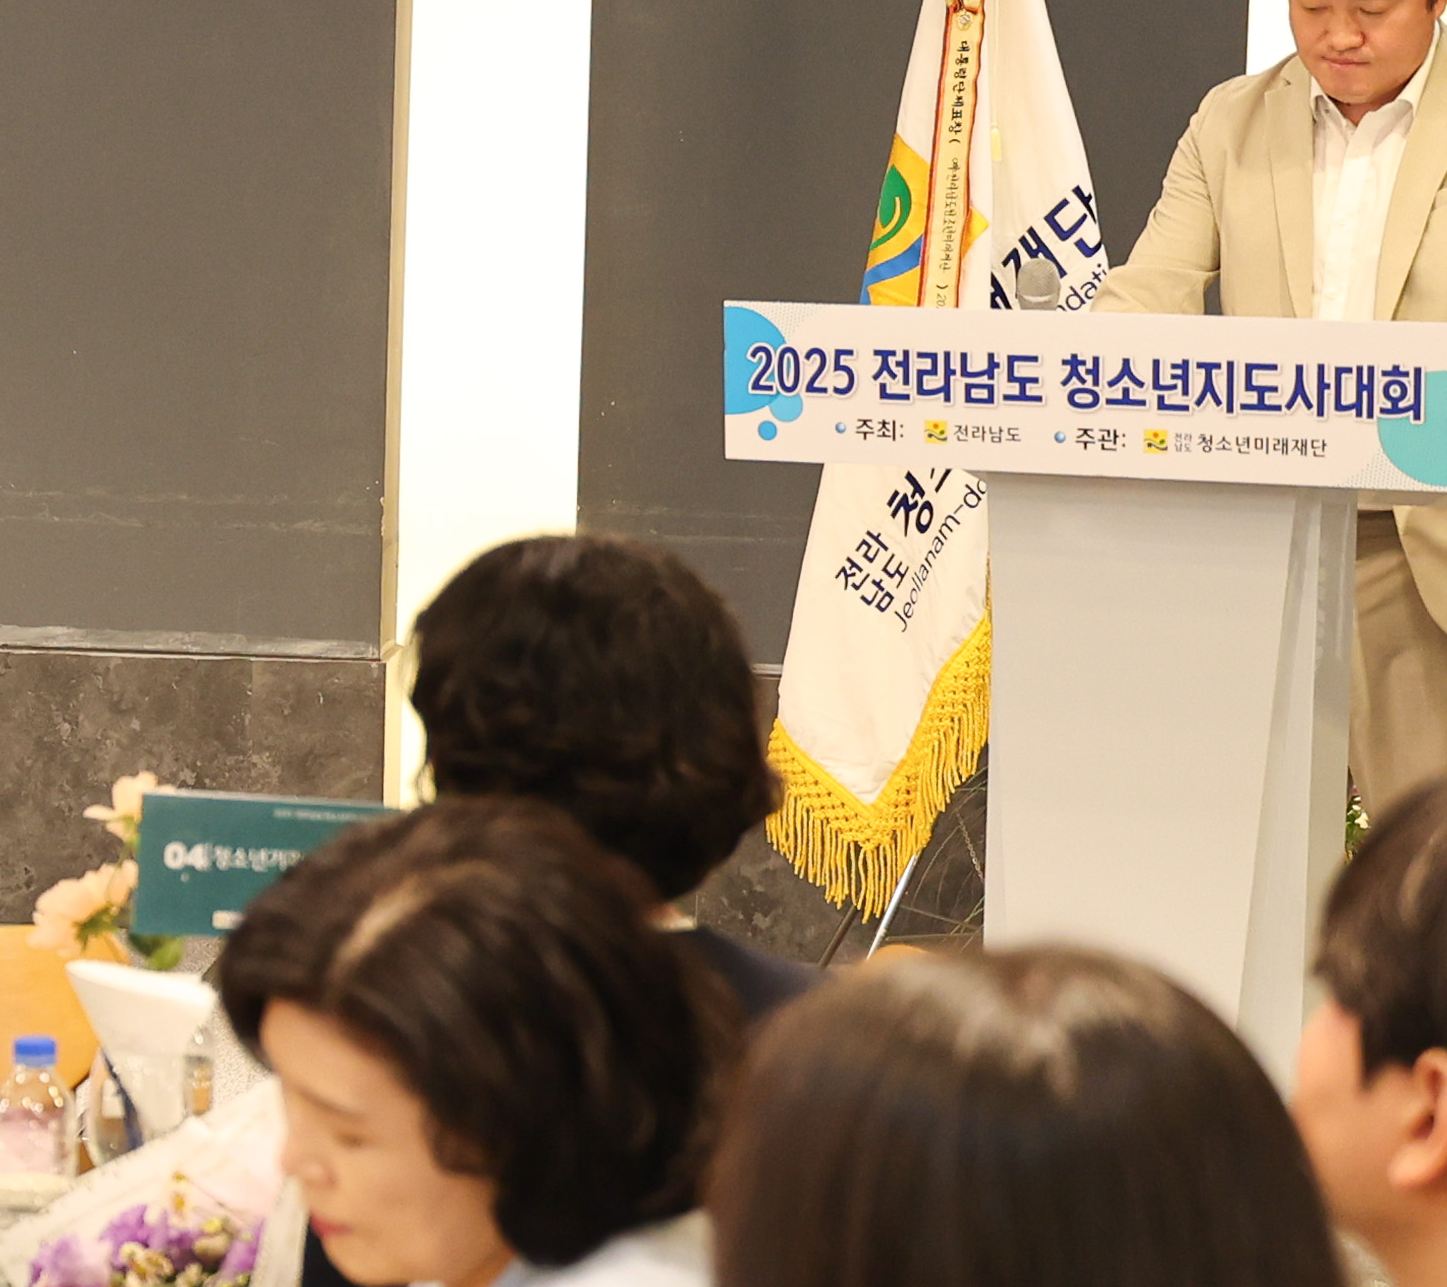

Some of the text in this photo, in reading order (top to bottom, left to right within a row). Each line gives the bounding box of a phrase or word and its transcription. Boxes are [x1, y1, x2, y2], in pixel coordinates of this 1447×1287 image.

[749, 345, 1423, 422] 2025 전라남도 청소년지도사대회
[855, 419, 1022, 443] 주최: 전라남도
[1075, 427, 1127, 452] 주관:
[1197, 434, 1328, 458] 청소년미래재단
[834, 529, 890, 591] 전라
[859, 552, 910, 613] 남도
